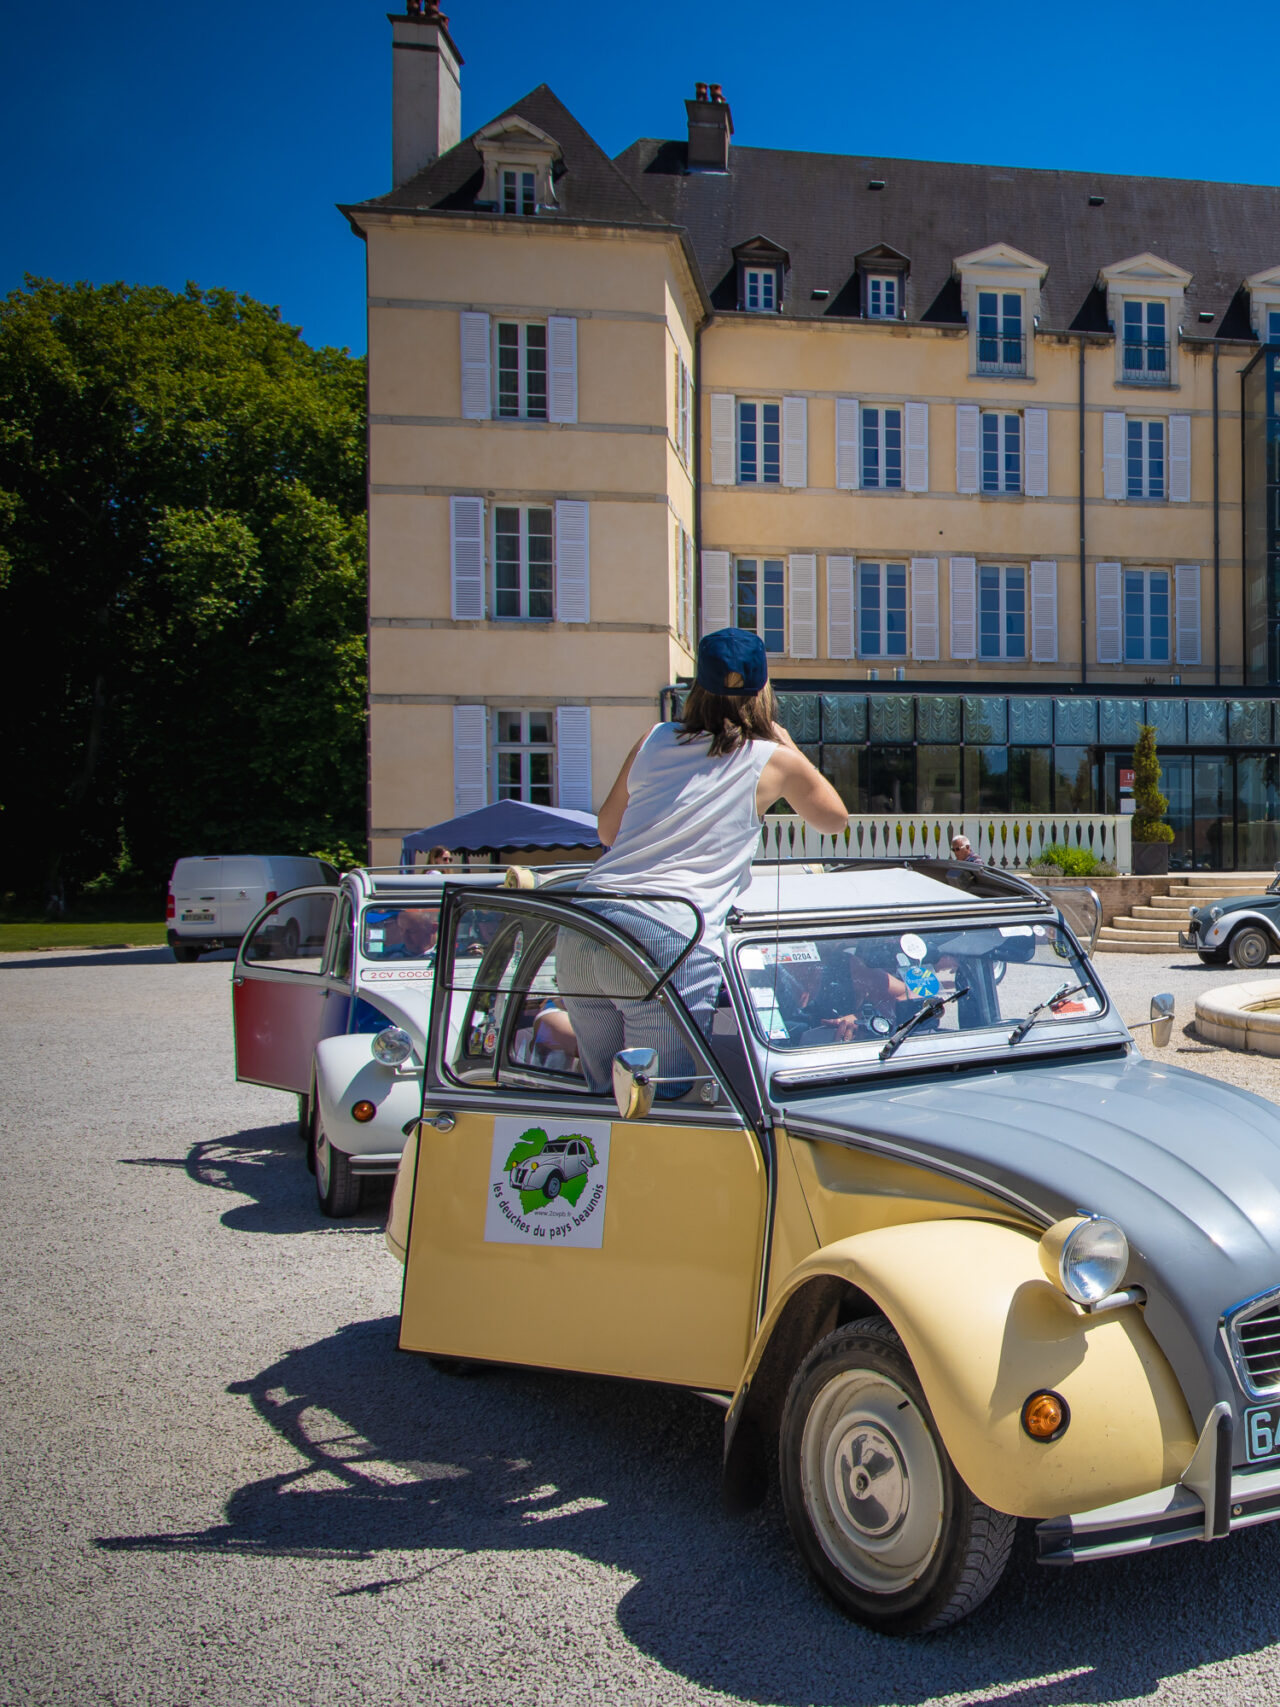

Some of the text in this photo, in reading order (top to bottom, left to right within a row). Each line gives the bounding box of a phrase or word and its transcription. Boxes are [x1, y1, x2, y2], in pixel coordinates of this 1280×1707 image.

[792, 953, 812, 961] 0204
[493, 1182, 604, 1240] les deuches du pays beaunois
